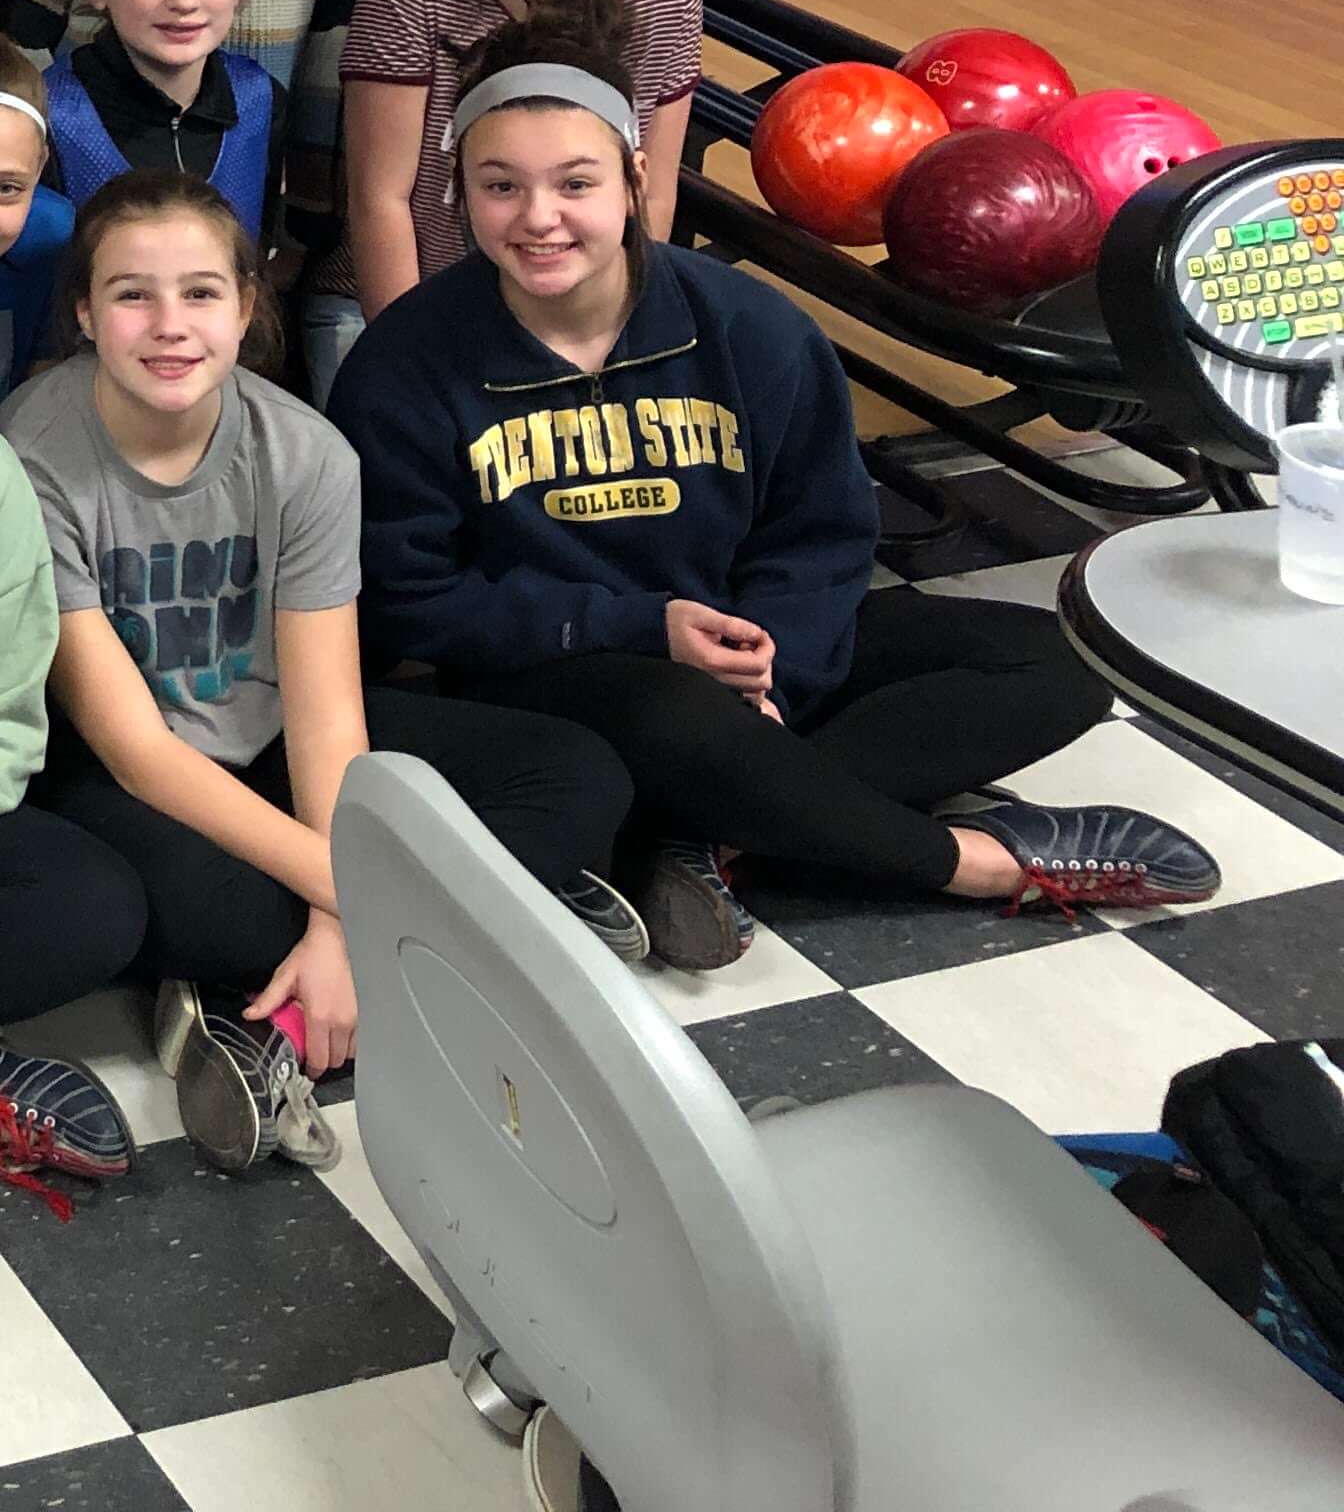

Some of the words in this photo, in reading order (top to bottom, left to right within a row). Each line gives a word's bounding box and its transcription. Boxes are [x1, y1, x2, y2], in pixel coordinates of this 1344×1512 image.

[468, 402, 635, 505] TRENTON
[635, 397, 746, 473] STATE
[558, 486, 667, 515] COLLEGE
